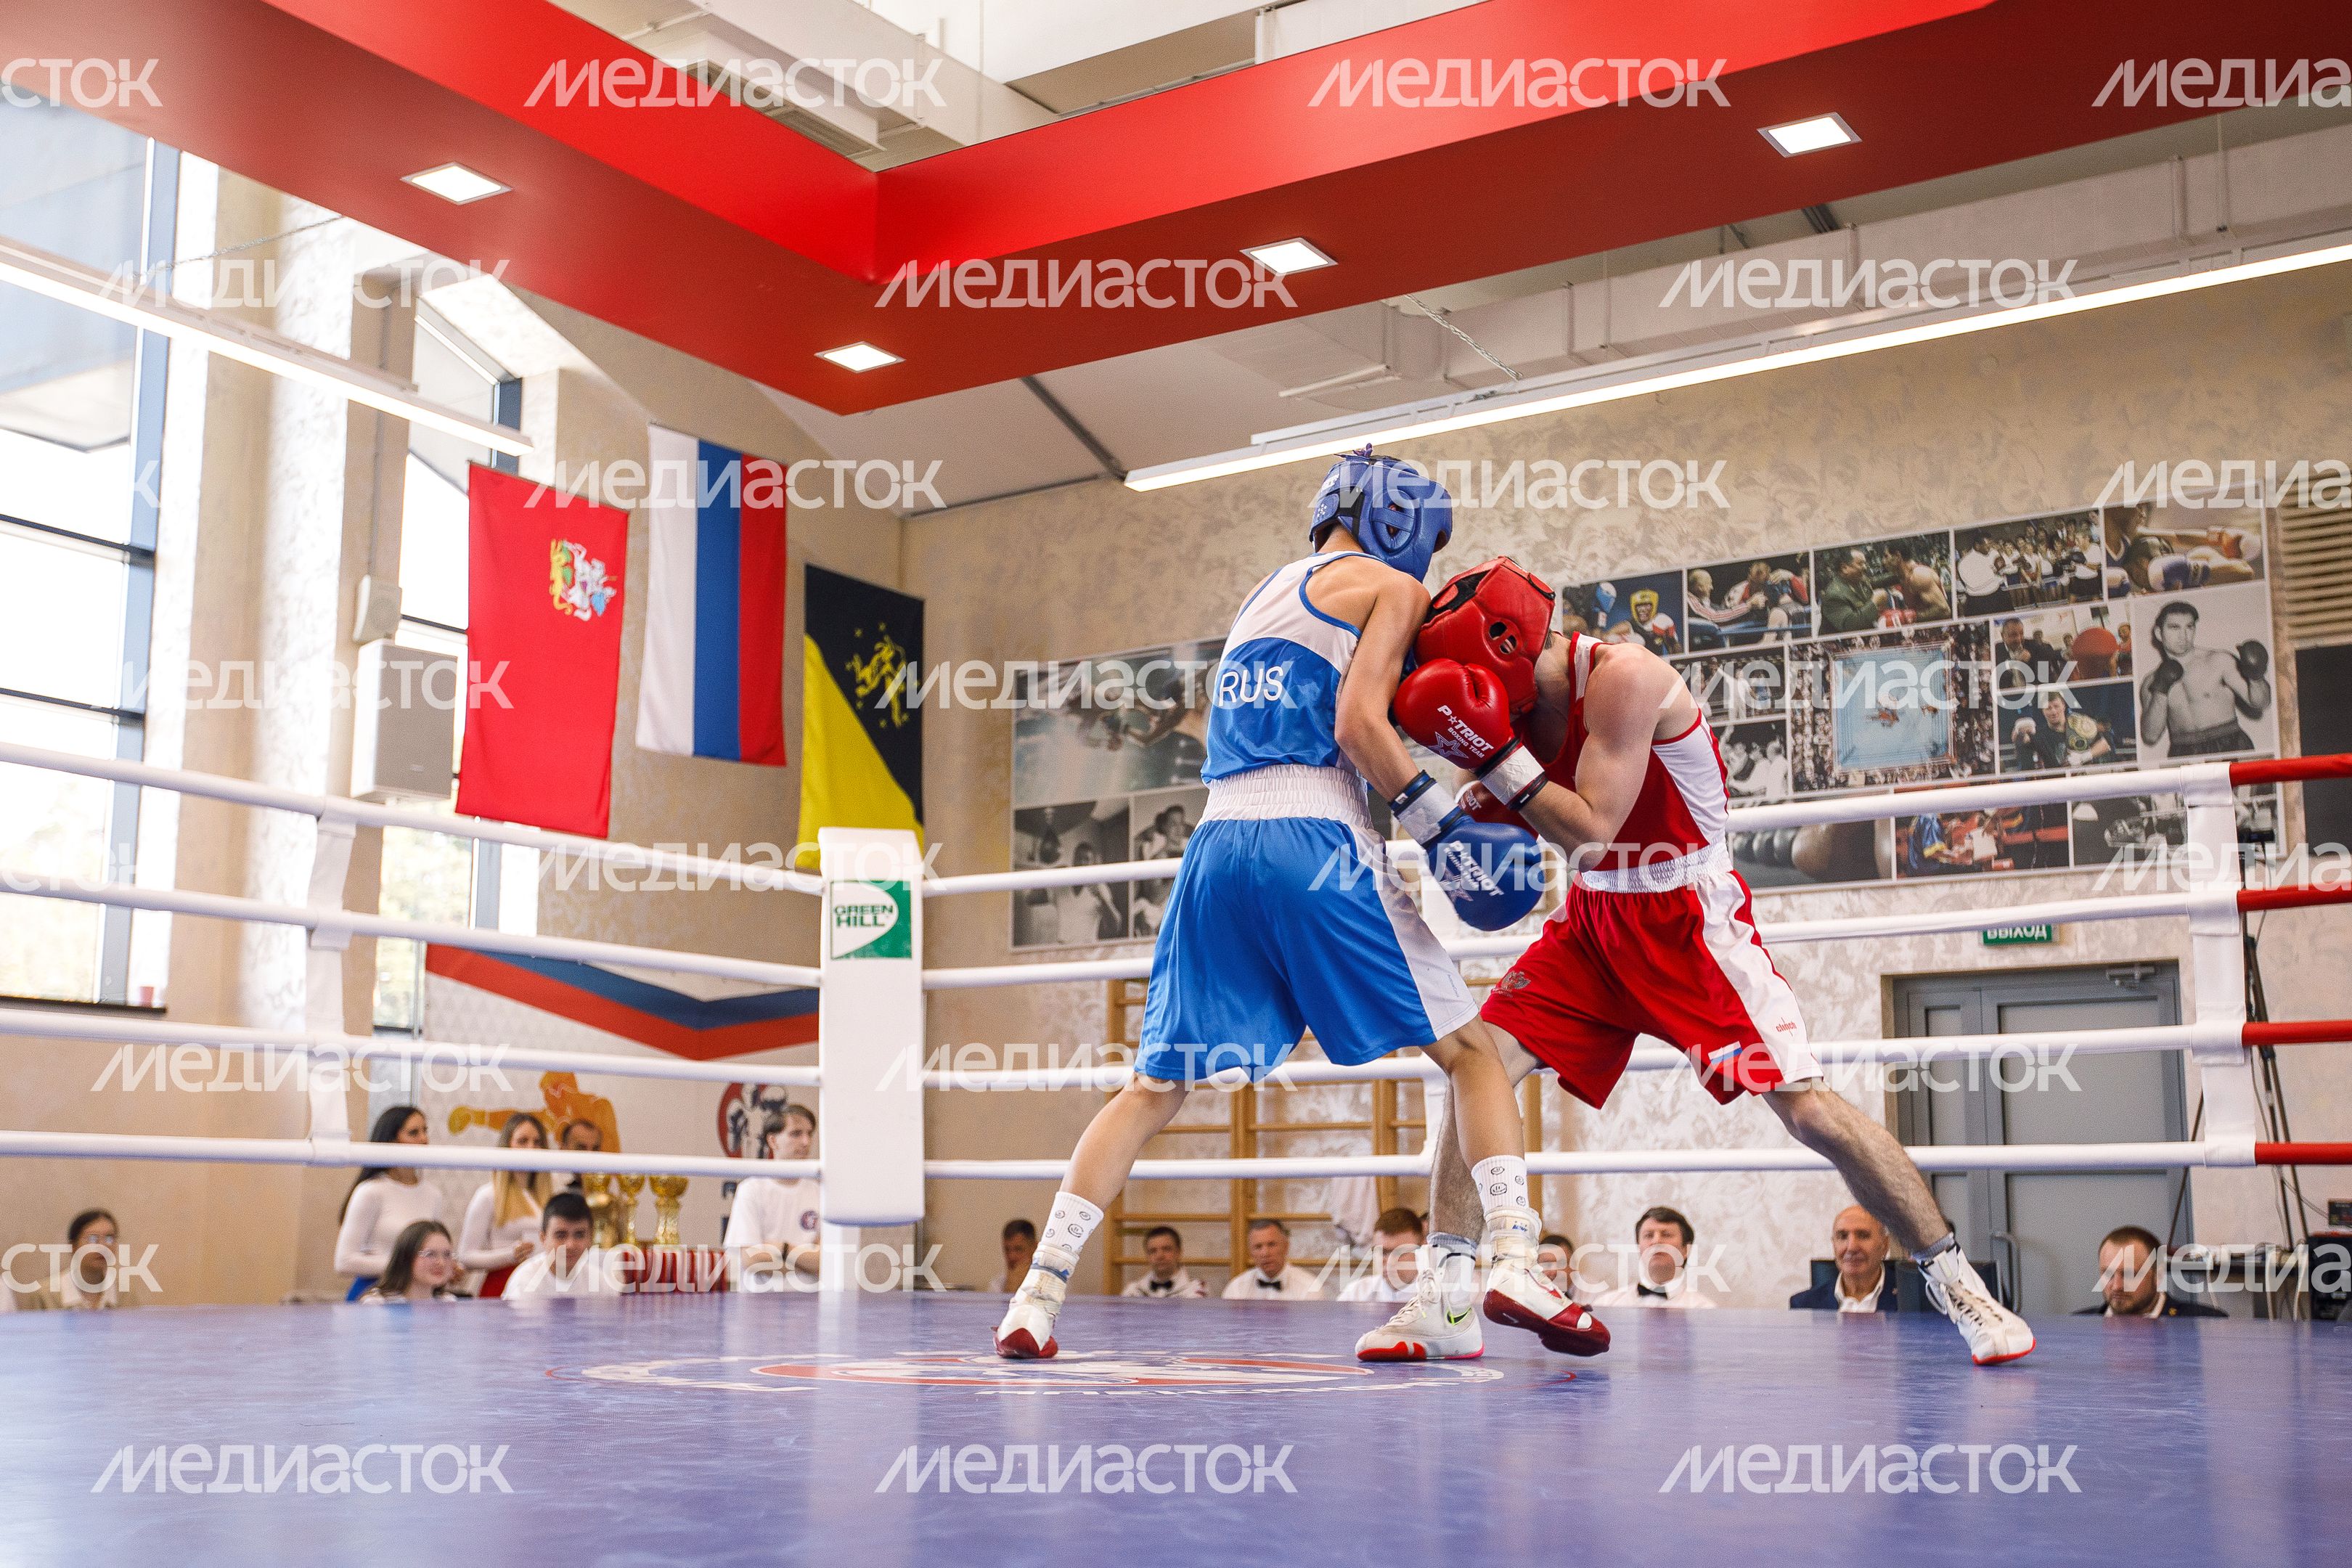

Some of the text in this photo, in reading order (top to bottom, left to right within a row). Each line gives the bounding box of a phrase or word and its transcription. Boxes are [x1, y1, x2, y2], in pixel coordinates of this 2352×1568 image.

[1218, 666, 1283, 707] RUS
[1447, 727, 1485, 758] BOXING TEAM
[834, 905, 894, 914] GREEN
[836, 915, 886, 927] HILL
